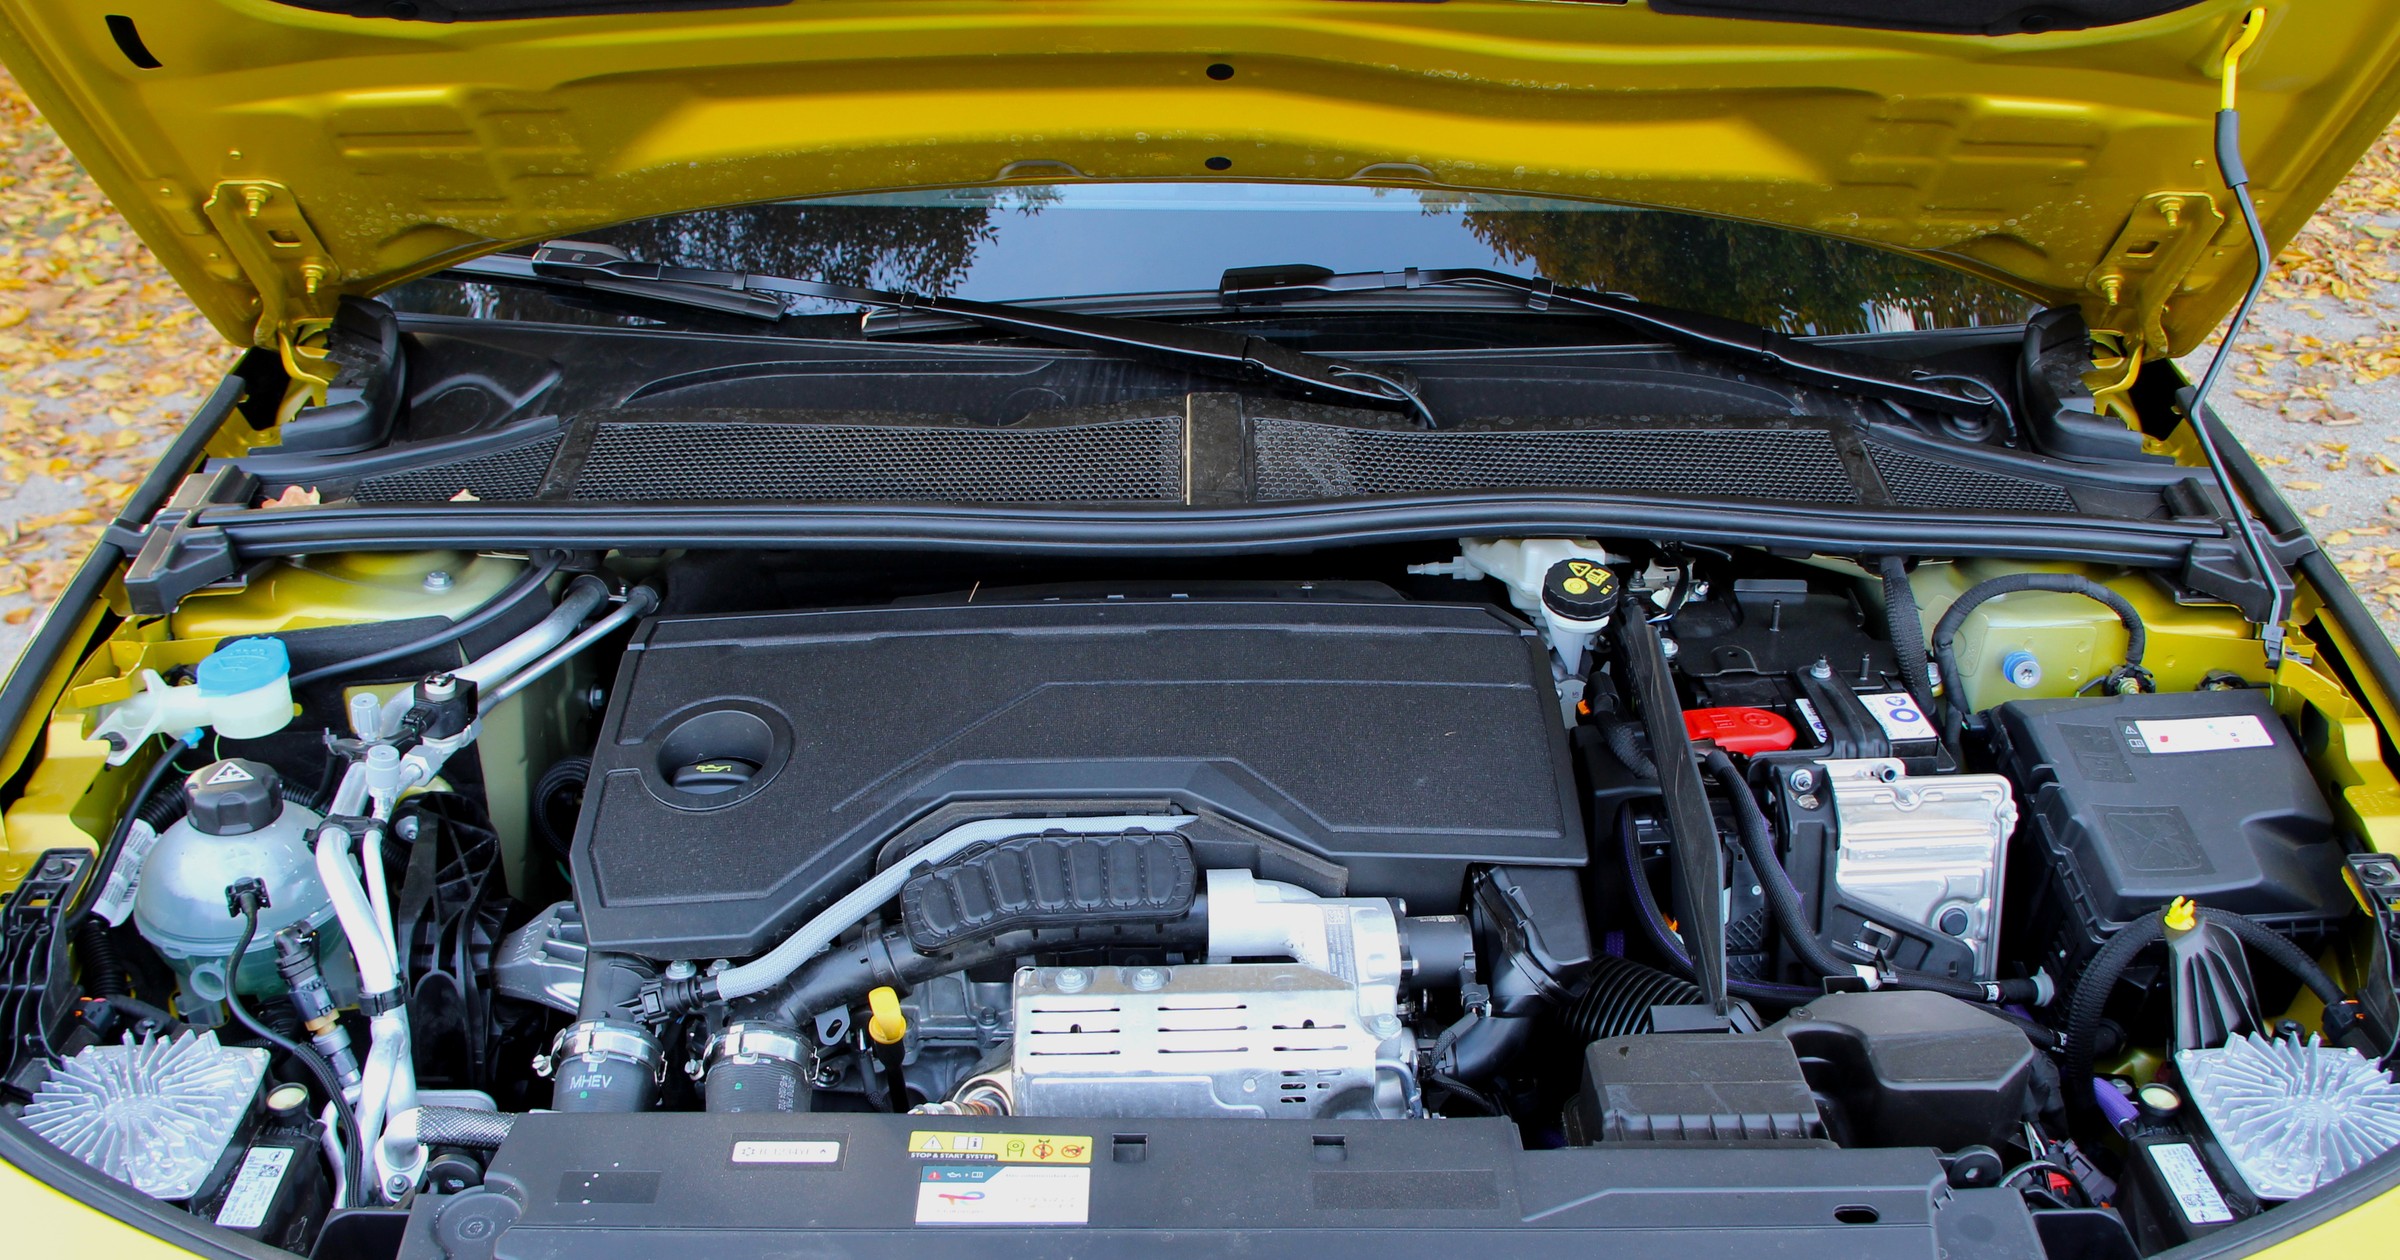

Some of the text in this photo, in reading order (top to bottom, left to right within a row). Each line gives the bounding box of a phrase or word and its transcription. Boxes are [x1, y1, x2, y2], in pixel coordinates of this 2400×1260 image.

[569, 1074, 613, 1090] MHEV
[910, 1151, 932, 1159] STOP
[940, 1152, 965, 1160] START
[965, 1153, 996, 1161] SYSTEM
